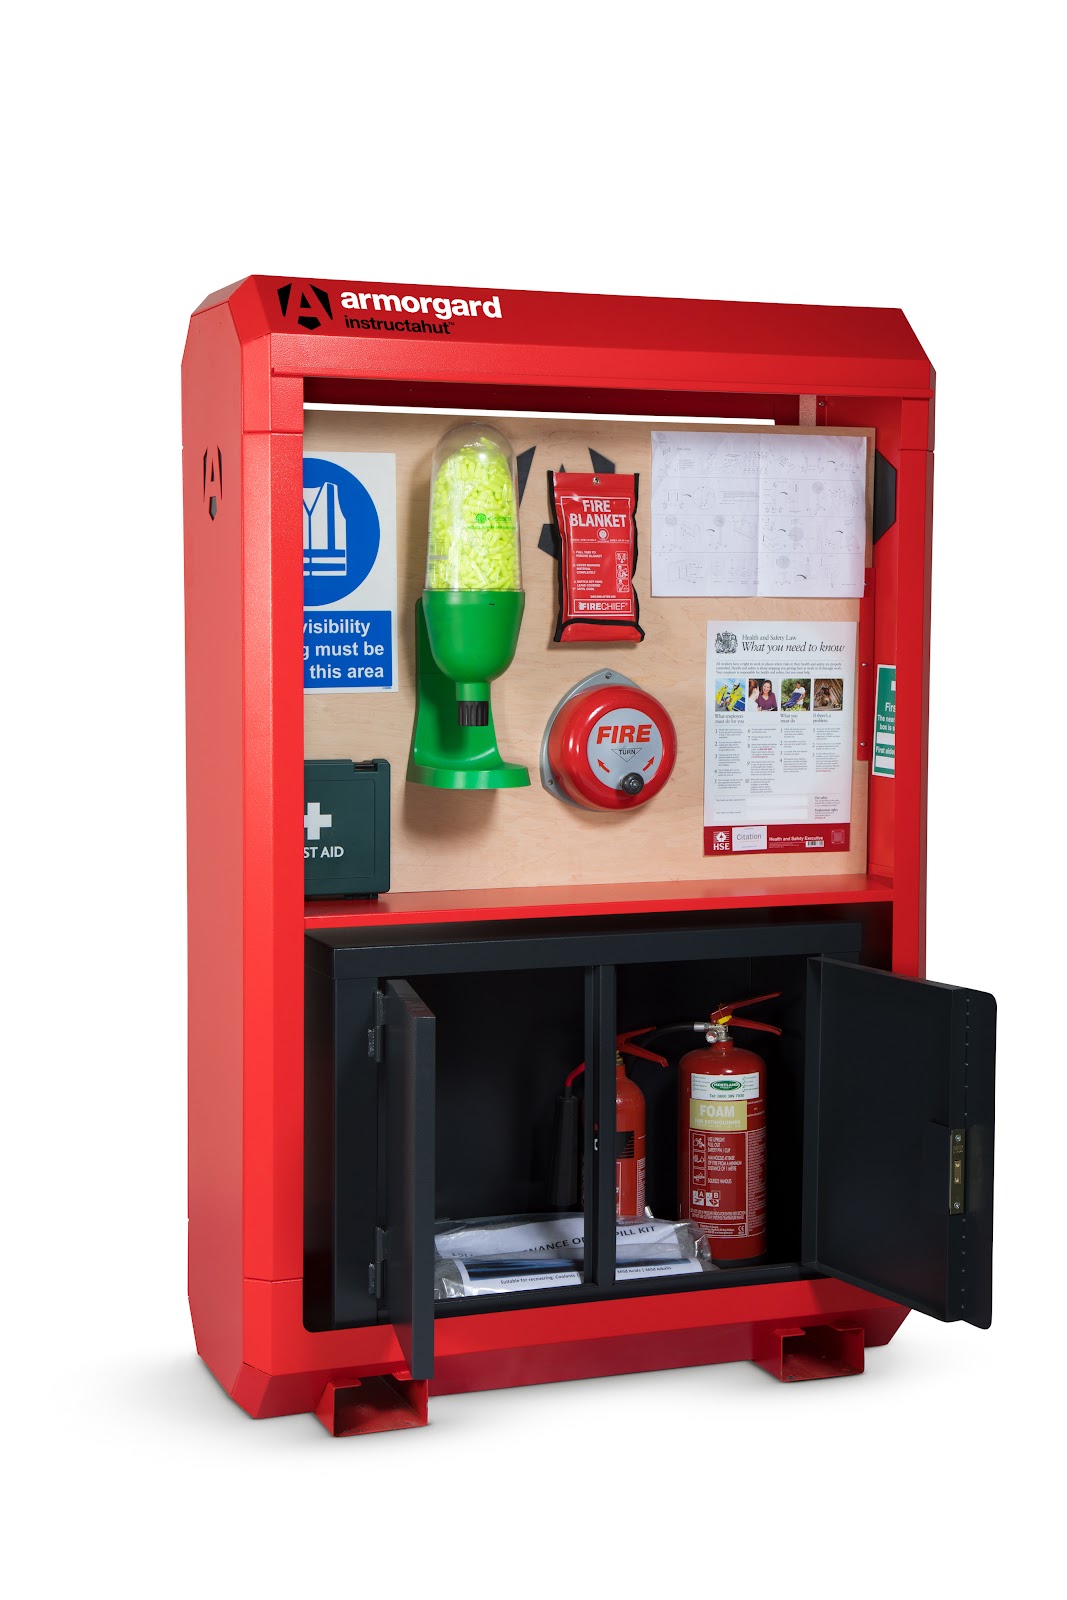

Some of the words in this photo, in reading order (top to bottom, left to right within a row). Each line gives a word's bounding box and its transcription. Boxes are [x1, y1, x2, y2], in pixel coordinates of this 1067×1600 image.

[340, 292, 502, 320] armorgard
[582, 500, 612, 512] FIRE
[570, 513, 626, 528] BLANKET
[315, 642, 358, 656] must
[364, 641, 384, 656] be
[742, 642, 764, 652] What
[767, 644, 783, 654] you
[786, 642, 806, 652] need
[808, 643, 817, 652] to
[819, 642, 845, 652] know
[309, 664, 342, 679] this
[347, 666, 384, 678] area
[596, 724, 652, 744] FIRE
[320, 846, 344, 858] AID
[700, 1104, 735, 1118] FOAM
[520, 1238, 570, 1252] NANCE
